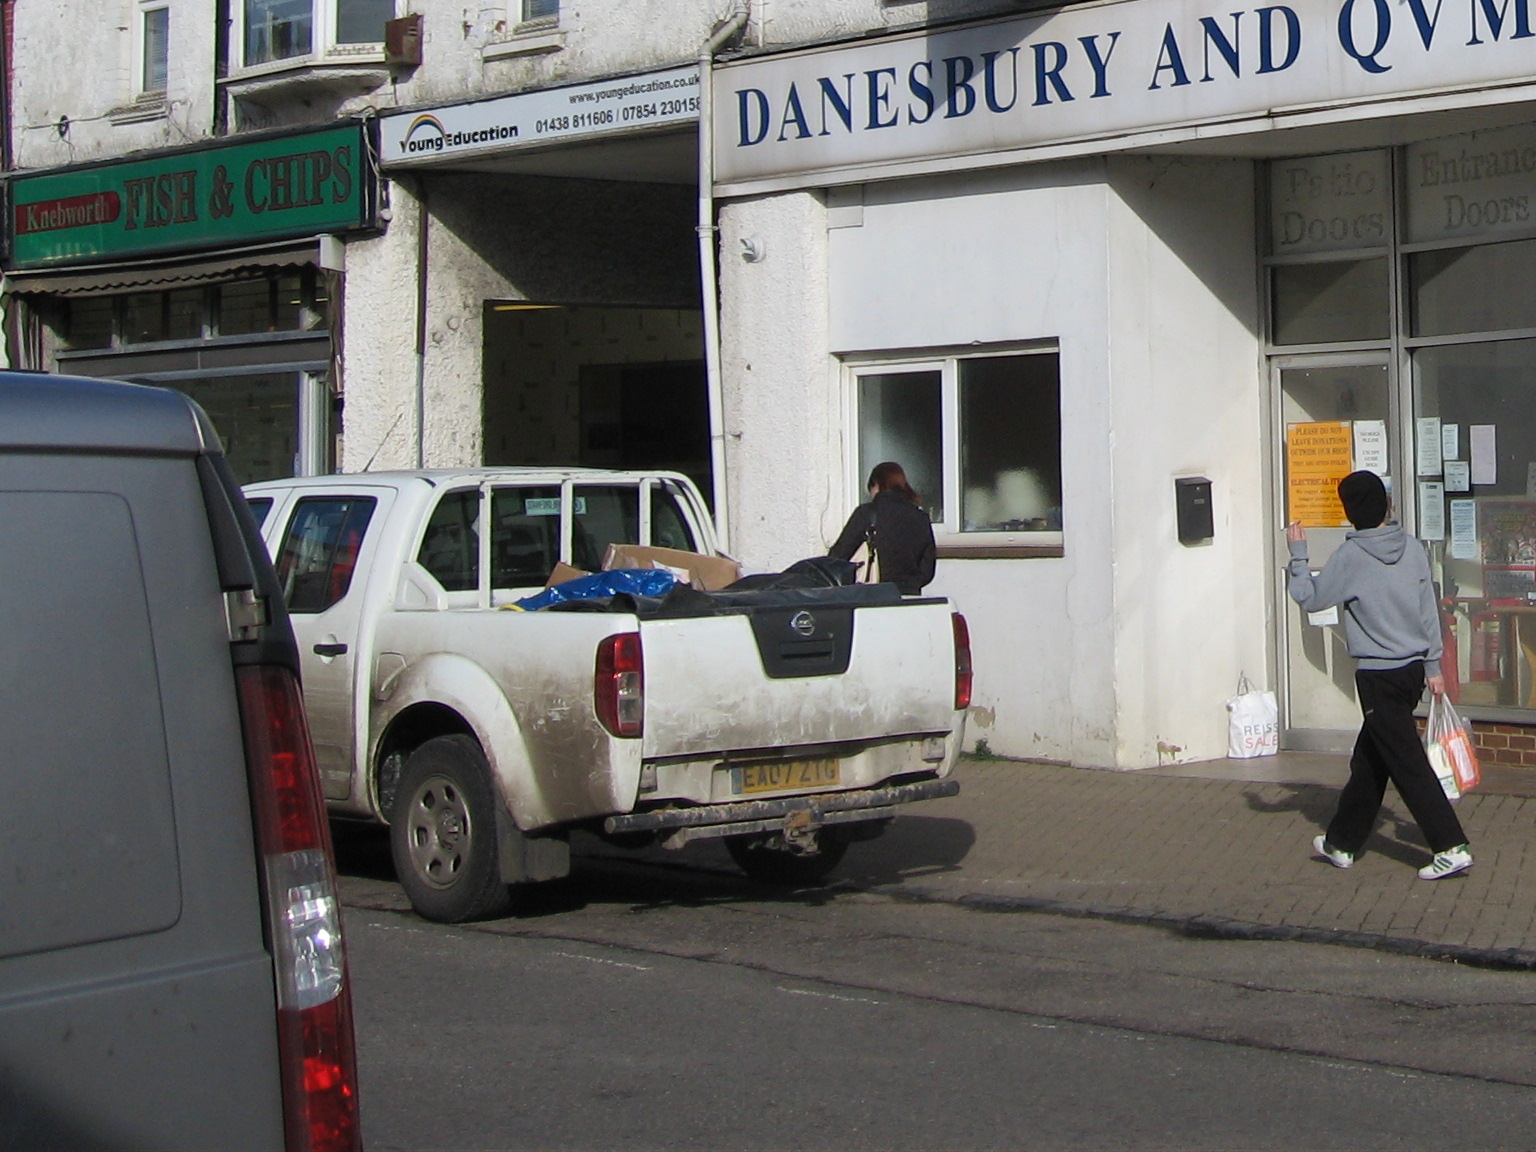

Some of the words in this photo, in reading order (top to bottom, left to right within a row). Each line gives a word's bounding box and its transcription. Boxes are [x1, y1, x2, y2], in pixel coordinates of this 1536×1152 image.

[569, 74, 700, 105] www.youngeducation.co.uk
[735, 31, 1121, 147] DANESBURY
[1148, 5, 1300, 91] AND
[535, 116, 569, 134] 01438
[573, 110, 614, 128] 811606
[622, 103, 657, 121] 07854
[26, 198, 112, 231] Knebworth
[123, 170, 198, 231] FISH
[209, 165, 235, 220] &
[245, 145, 353, 215] CHIPS
[1285, 164, 1375, 203] Patio
[1280, 210, 1384, 246] Doors
[1444, 193, 1530, 231] Doors
[1243, 722, 1279, 736] REISS
[1245, 737, 1278, 749] SALE
